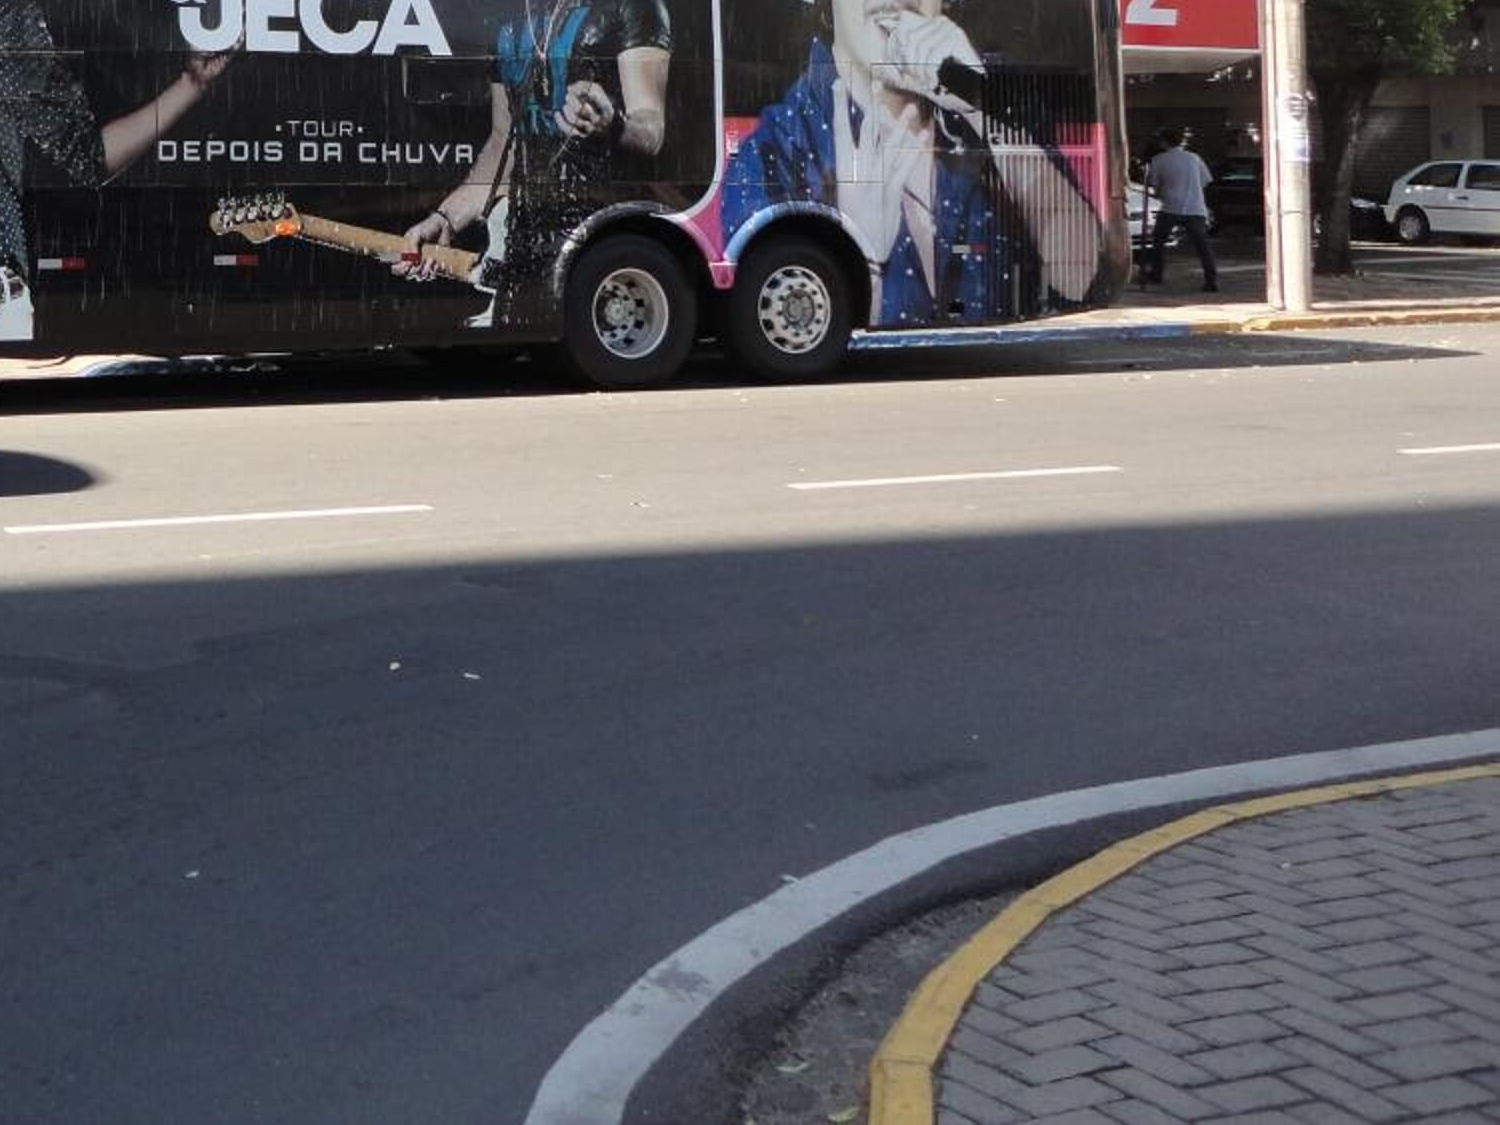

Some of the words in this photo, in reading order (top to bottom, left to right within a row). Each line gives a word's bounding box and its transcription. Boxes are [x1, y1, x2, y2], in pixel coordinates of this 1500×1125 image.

[157, 140, 283, 162] DEPOIS
[299, 141, 342, 162] DA
[358, 142, 474, 163] CHUVA
